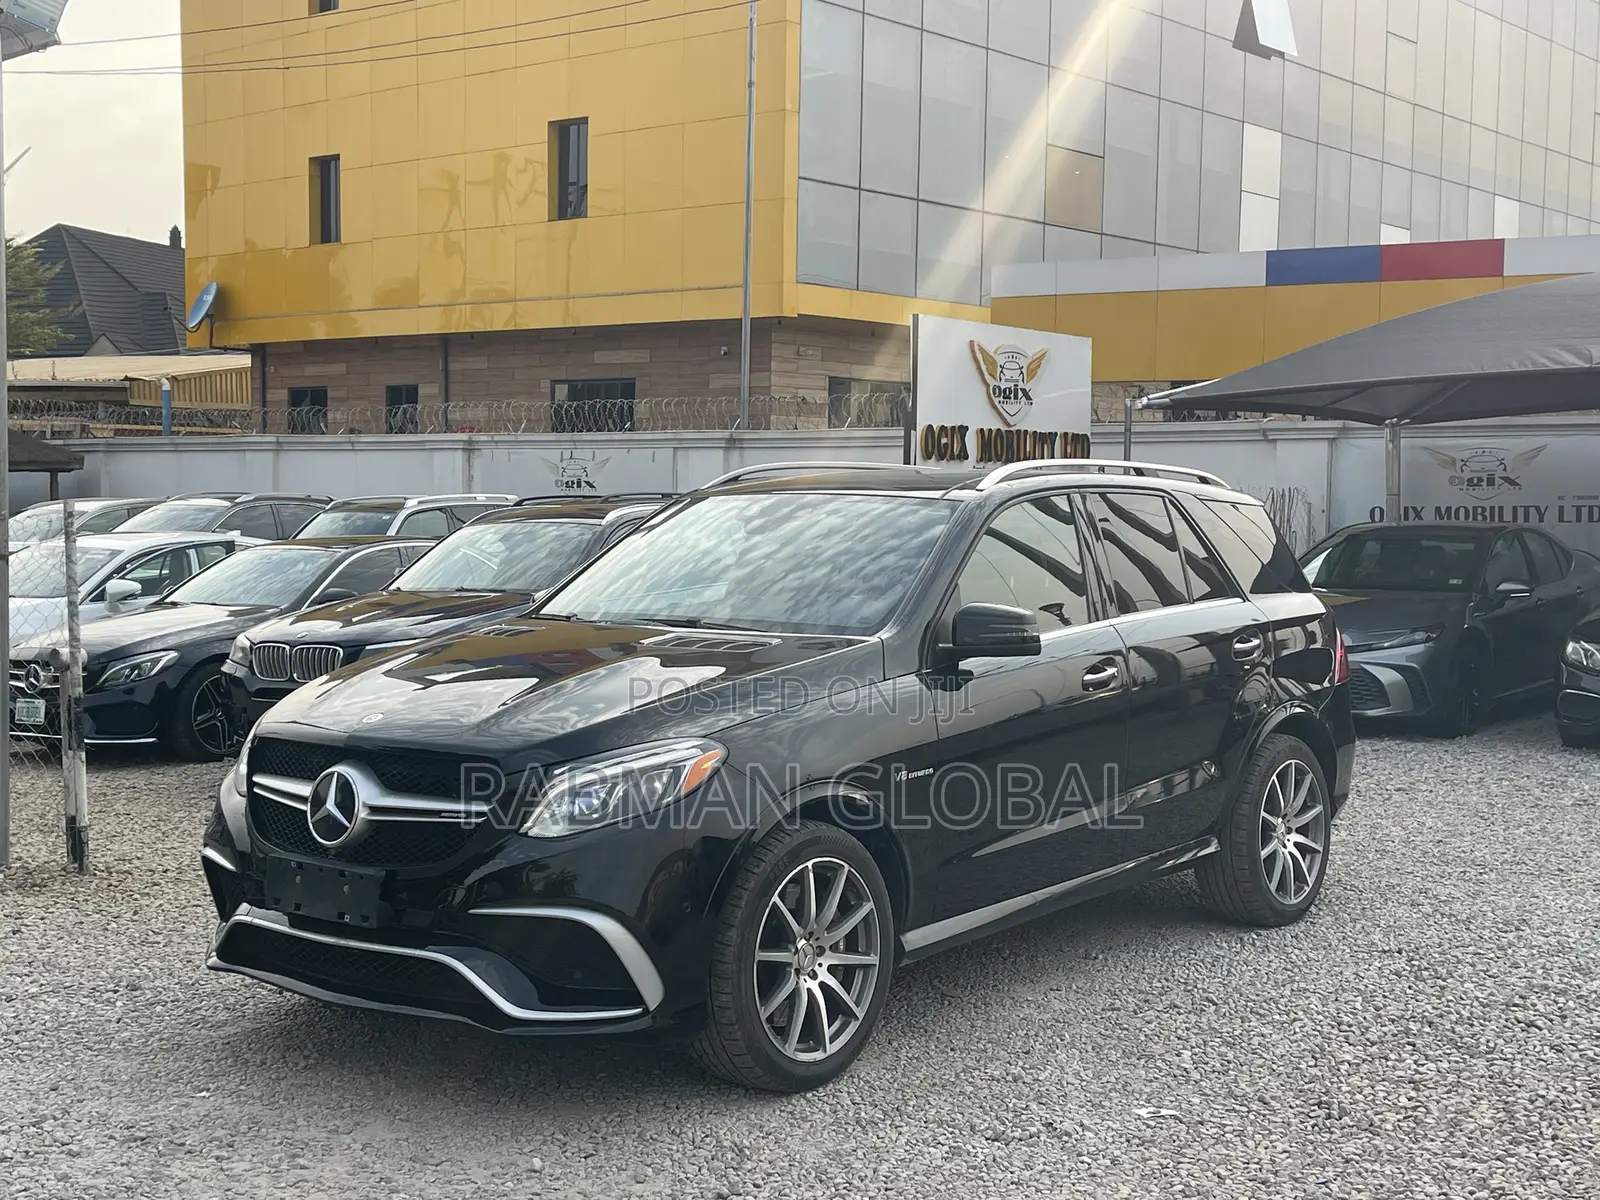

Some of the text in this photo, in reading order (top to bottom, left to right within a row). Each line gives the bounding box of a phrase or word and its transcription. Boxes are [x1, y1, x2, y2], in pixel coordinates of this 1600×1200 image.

[920, 423, 1091, 463] OGIX MOBILITY LTD
[1369, 505, 1600, 523] OIX MOBILITY LTD
[894, 770, 908, 781] V8
